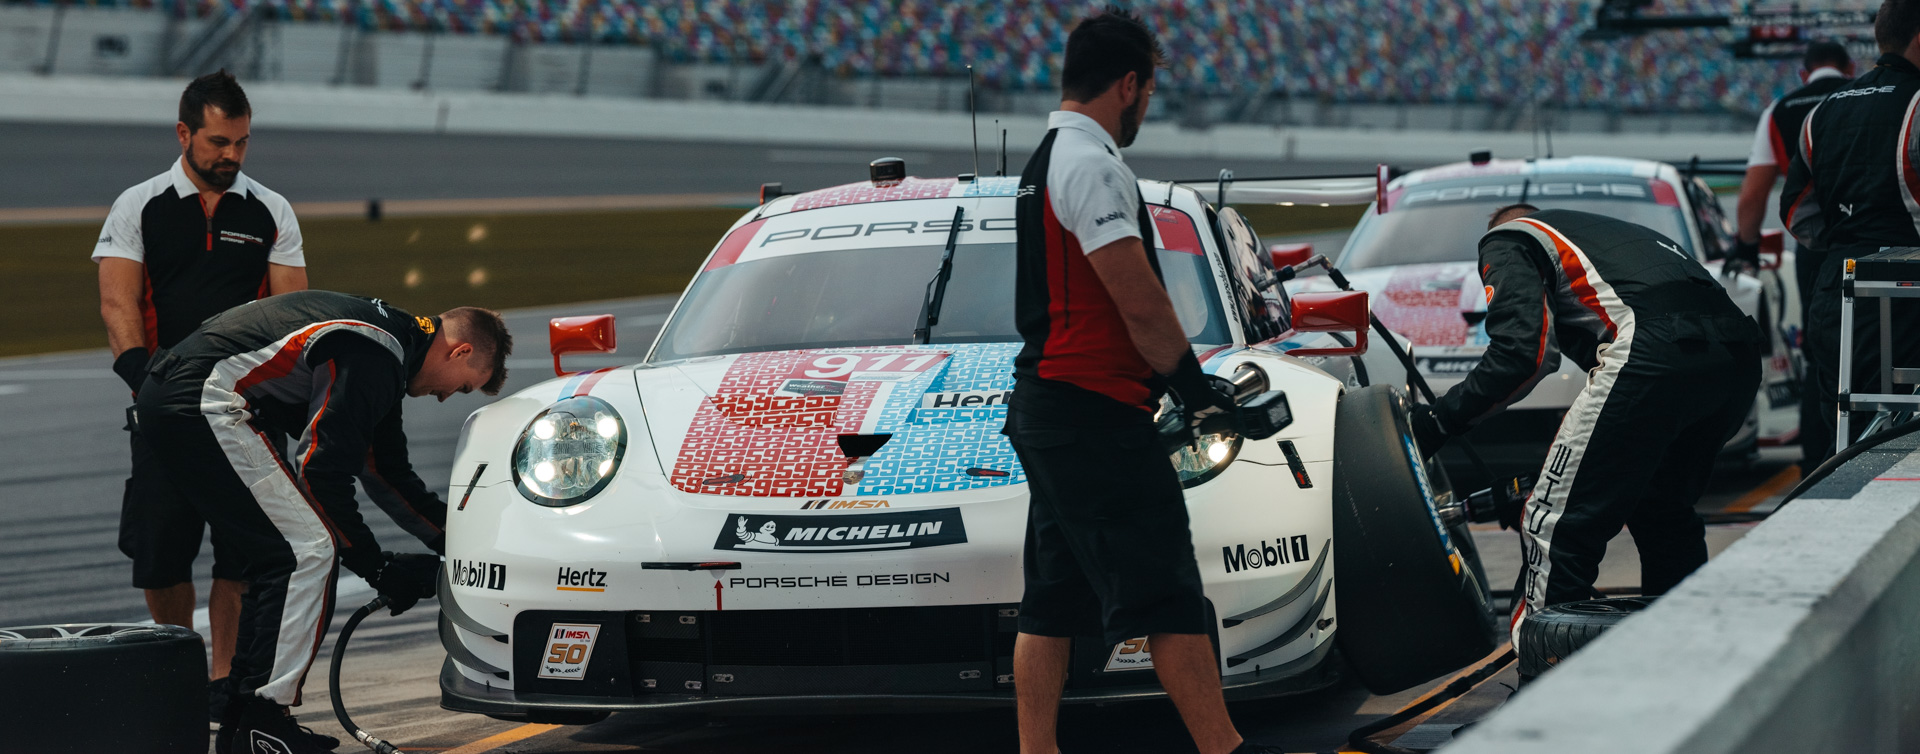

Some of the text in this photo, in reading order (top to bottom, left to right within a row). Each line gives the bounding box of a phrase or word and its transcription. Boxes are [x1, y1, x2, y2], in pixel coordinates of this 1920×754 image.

[1827, 85, 1896, 101] PORSCHE
[1404, 183, 1646, 205] PORSCHE
[220, 230, 263, 243] PORSCHE
[759, 217, 1017, 248] PORSC
[804, 354, 937, 378] 911
[933, 391, 1014, 408] Her
[828, 500, 891, 509] IMSA
[783, 520, 943, 541] MICHELIN
[1526, 443, 1573, 615] RSCHE
[1222, 536, 1308, 574] Mobil 1
[451, 559, 504, 590] Mobil 1
[557, 566, 607, 588] Hertz
[730, 572, 950, 589] PORSCHE DESIGN
[565, 630, 591, 639] IMSA
[547, 642, 588, 664] 50
